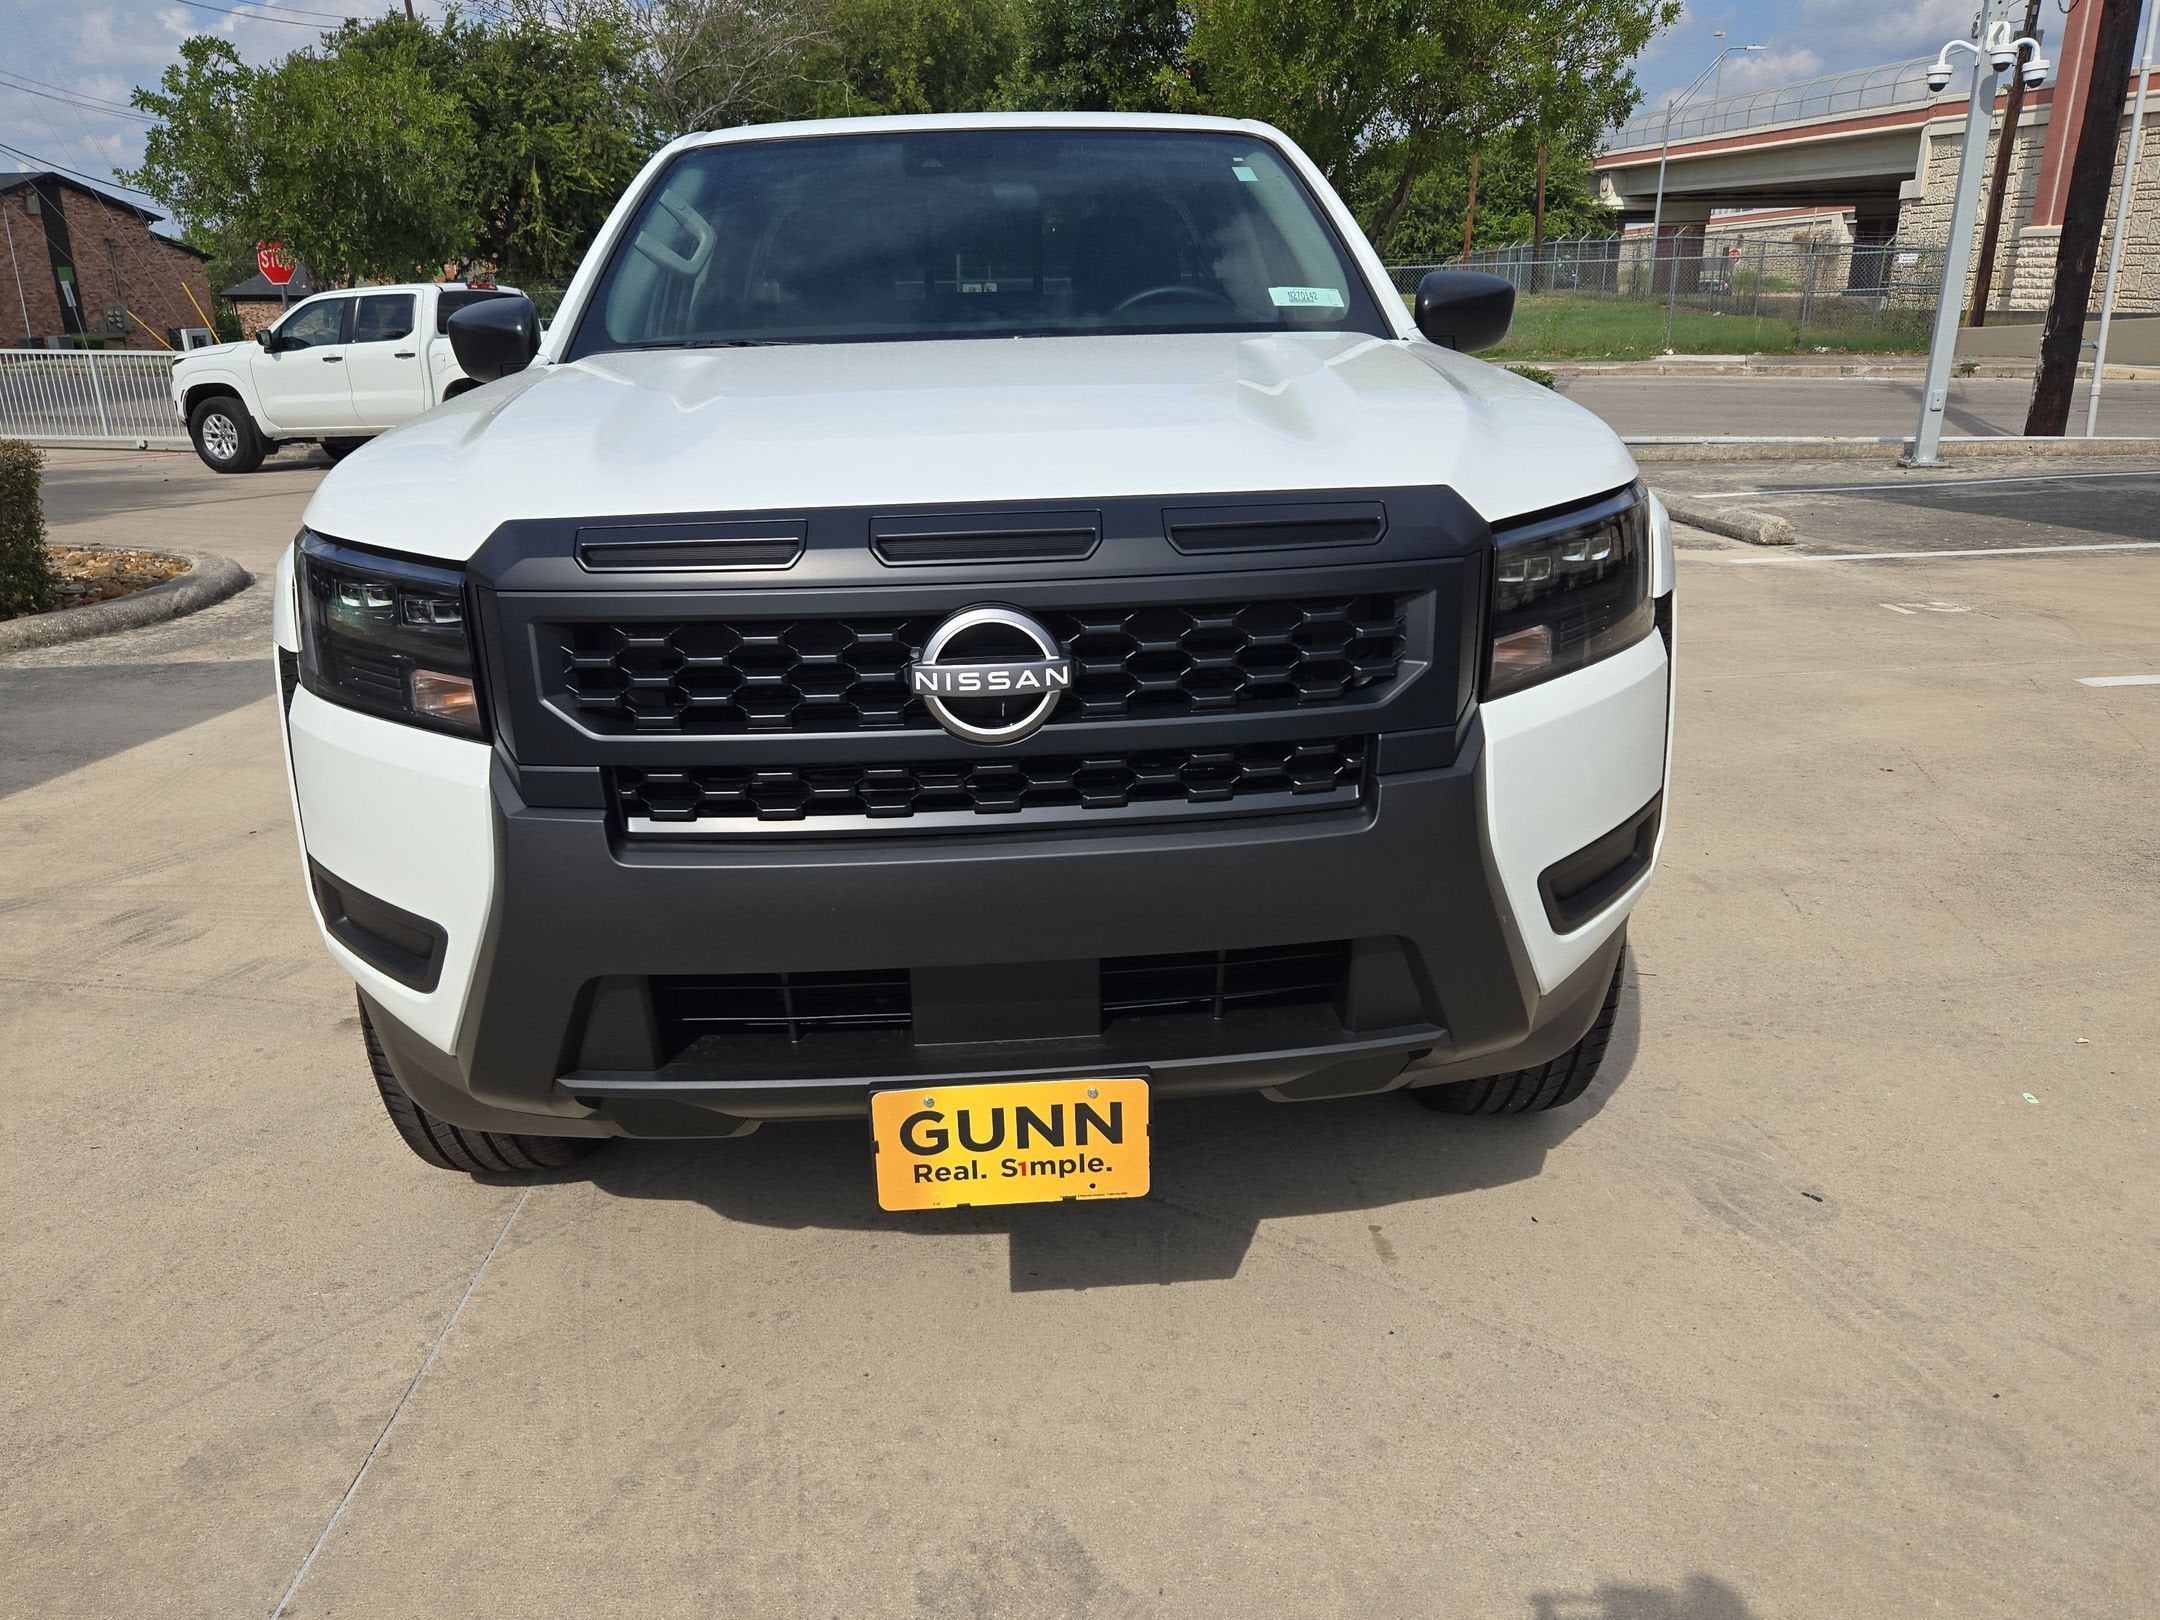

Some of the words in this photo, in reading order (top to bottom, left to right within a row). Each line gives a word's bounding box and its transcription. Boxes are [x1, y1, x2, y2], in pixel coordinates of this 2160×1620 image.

[915, 666, 1069, 691] NISSAN
[899, 1101, 1123, 1156] GUNN
[914, 1159, 987, 1183] Real.
[1001, 1153, 1113, 1178] S1mple.
